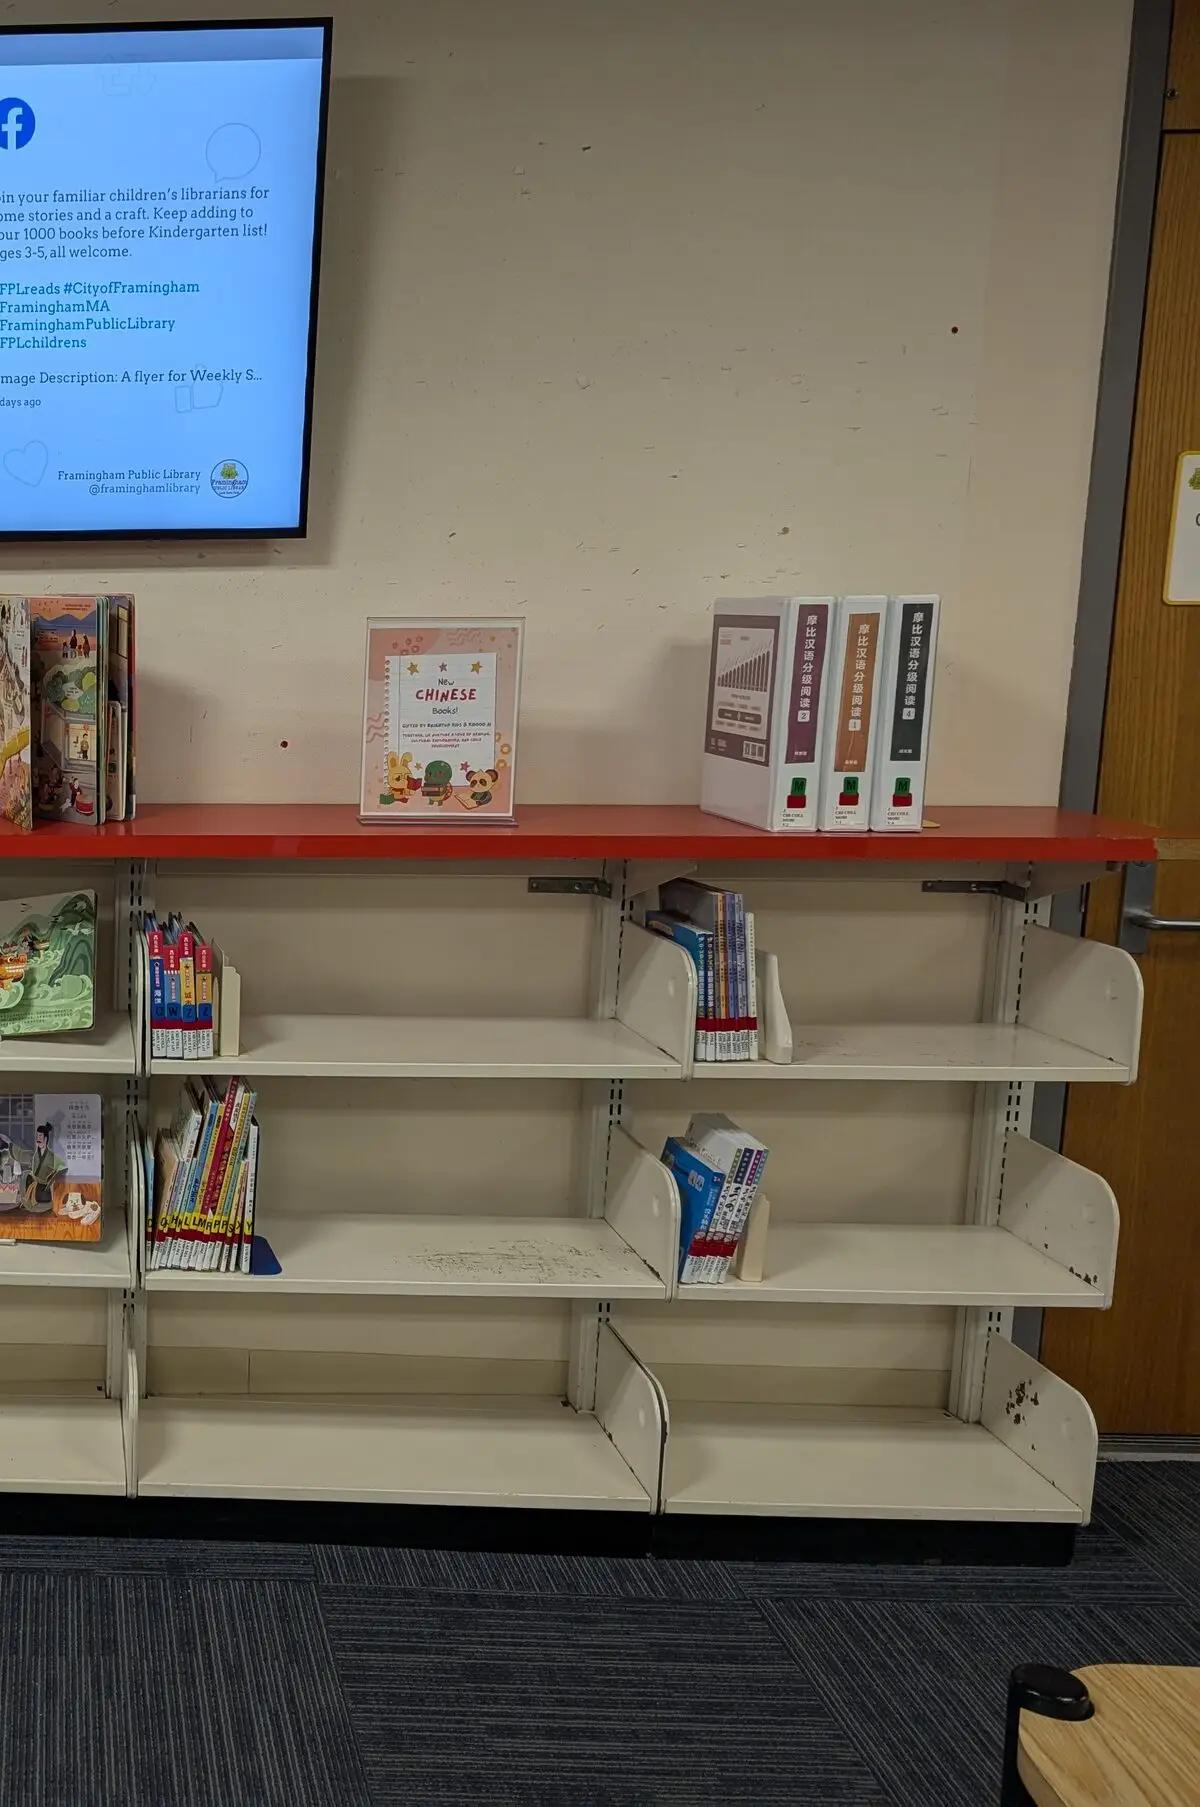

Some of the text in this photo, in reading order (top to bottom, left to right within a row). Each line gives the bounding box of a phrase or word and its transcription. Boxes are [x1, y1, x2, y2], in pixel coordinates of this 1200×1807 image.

[18, 191, 48, 205] your
[53, 189, 105, 202] familiar
[181, 188, 246, 200] librarians
[249, 186, 269, 199] for
[28, 208, 73, 221] stories
[77, 207, 101, 221] and
[105, 211, 112, 220] a
[115, 206, 149, 220] craft.
[154, 207, 187, 223] Keep
[191, 206, 236, 223] adding
[239, 207, 253, 218] to
[24, 227, 55, 240] 1000
[59, 226, 98, 239] books
[102, 225, 144, 239] before
[149, 224, 239, 241] Kindergarten
[242, 223, 267, 237] list!
[25, 246, 49, 261] 3-5,
[50, 245, 66, 258] all
[69, 245, 132, 258] welcome.
[63, 281, 200, 296] #CityofFramingham
[40, 371, 118, 386] Description:
[121, 371, 131, 383] A
[134, 369, 164, 385] flyer
[168, 369, 187, 382] for
[190, 369, 242, 383] Weekly
[0, 397, 21, 408] days
[24, 398, 41, 408] ago
[58, 468, 201, 482] Framingham Public Library
[89, 482, 200, 496] @framinghamlibrary
[799, 615, 818, 709] 摩比汉语分级阅读
[904, 612, 924, 706] 摩比汉语分级阅读
[850, 624, 870, 720] 摩比汉语分级阅读
[438, 678, 455, 686] New
[416, 689, 477, 703] CHINESE
[433, 707, 458, 715] Books!
[795, 781, 805, 791] M
[846, 781, 856, 790] M
[898, 781, 908, 791] M
[187, 1009, 192, 1017] Z
[184, 1216, 190, 1225] L
[247, 1222, 252, 1230] Y
